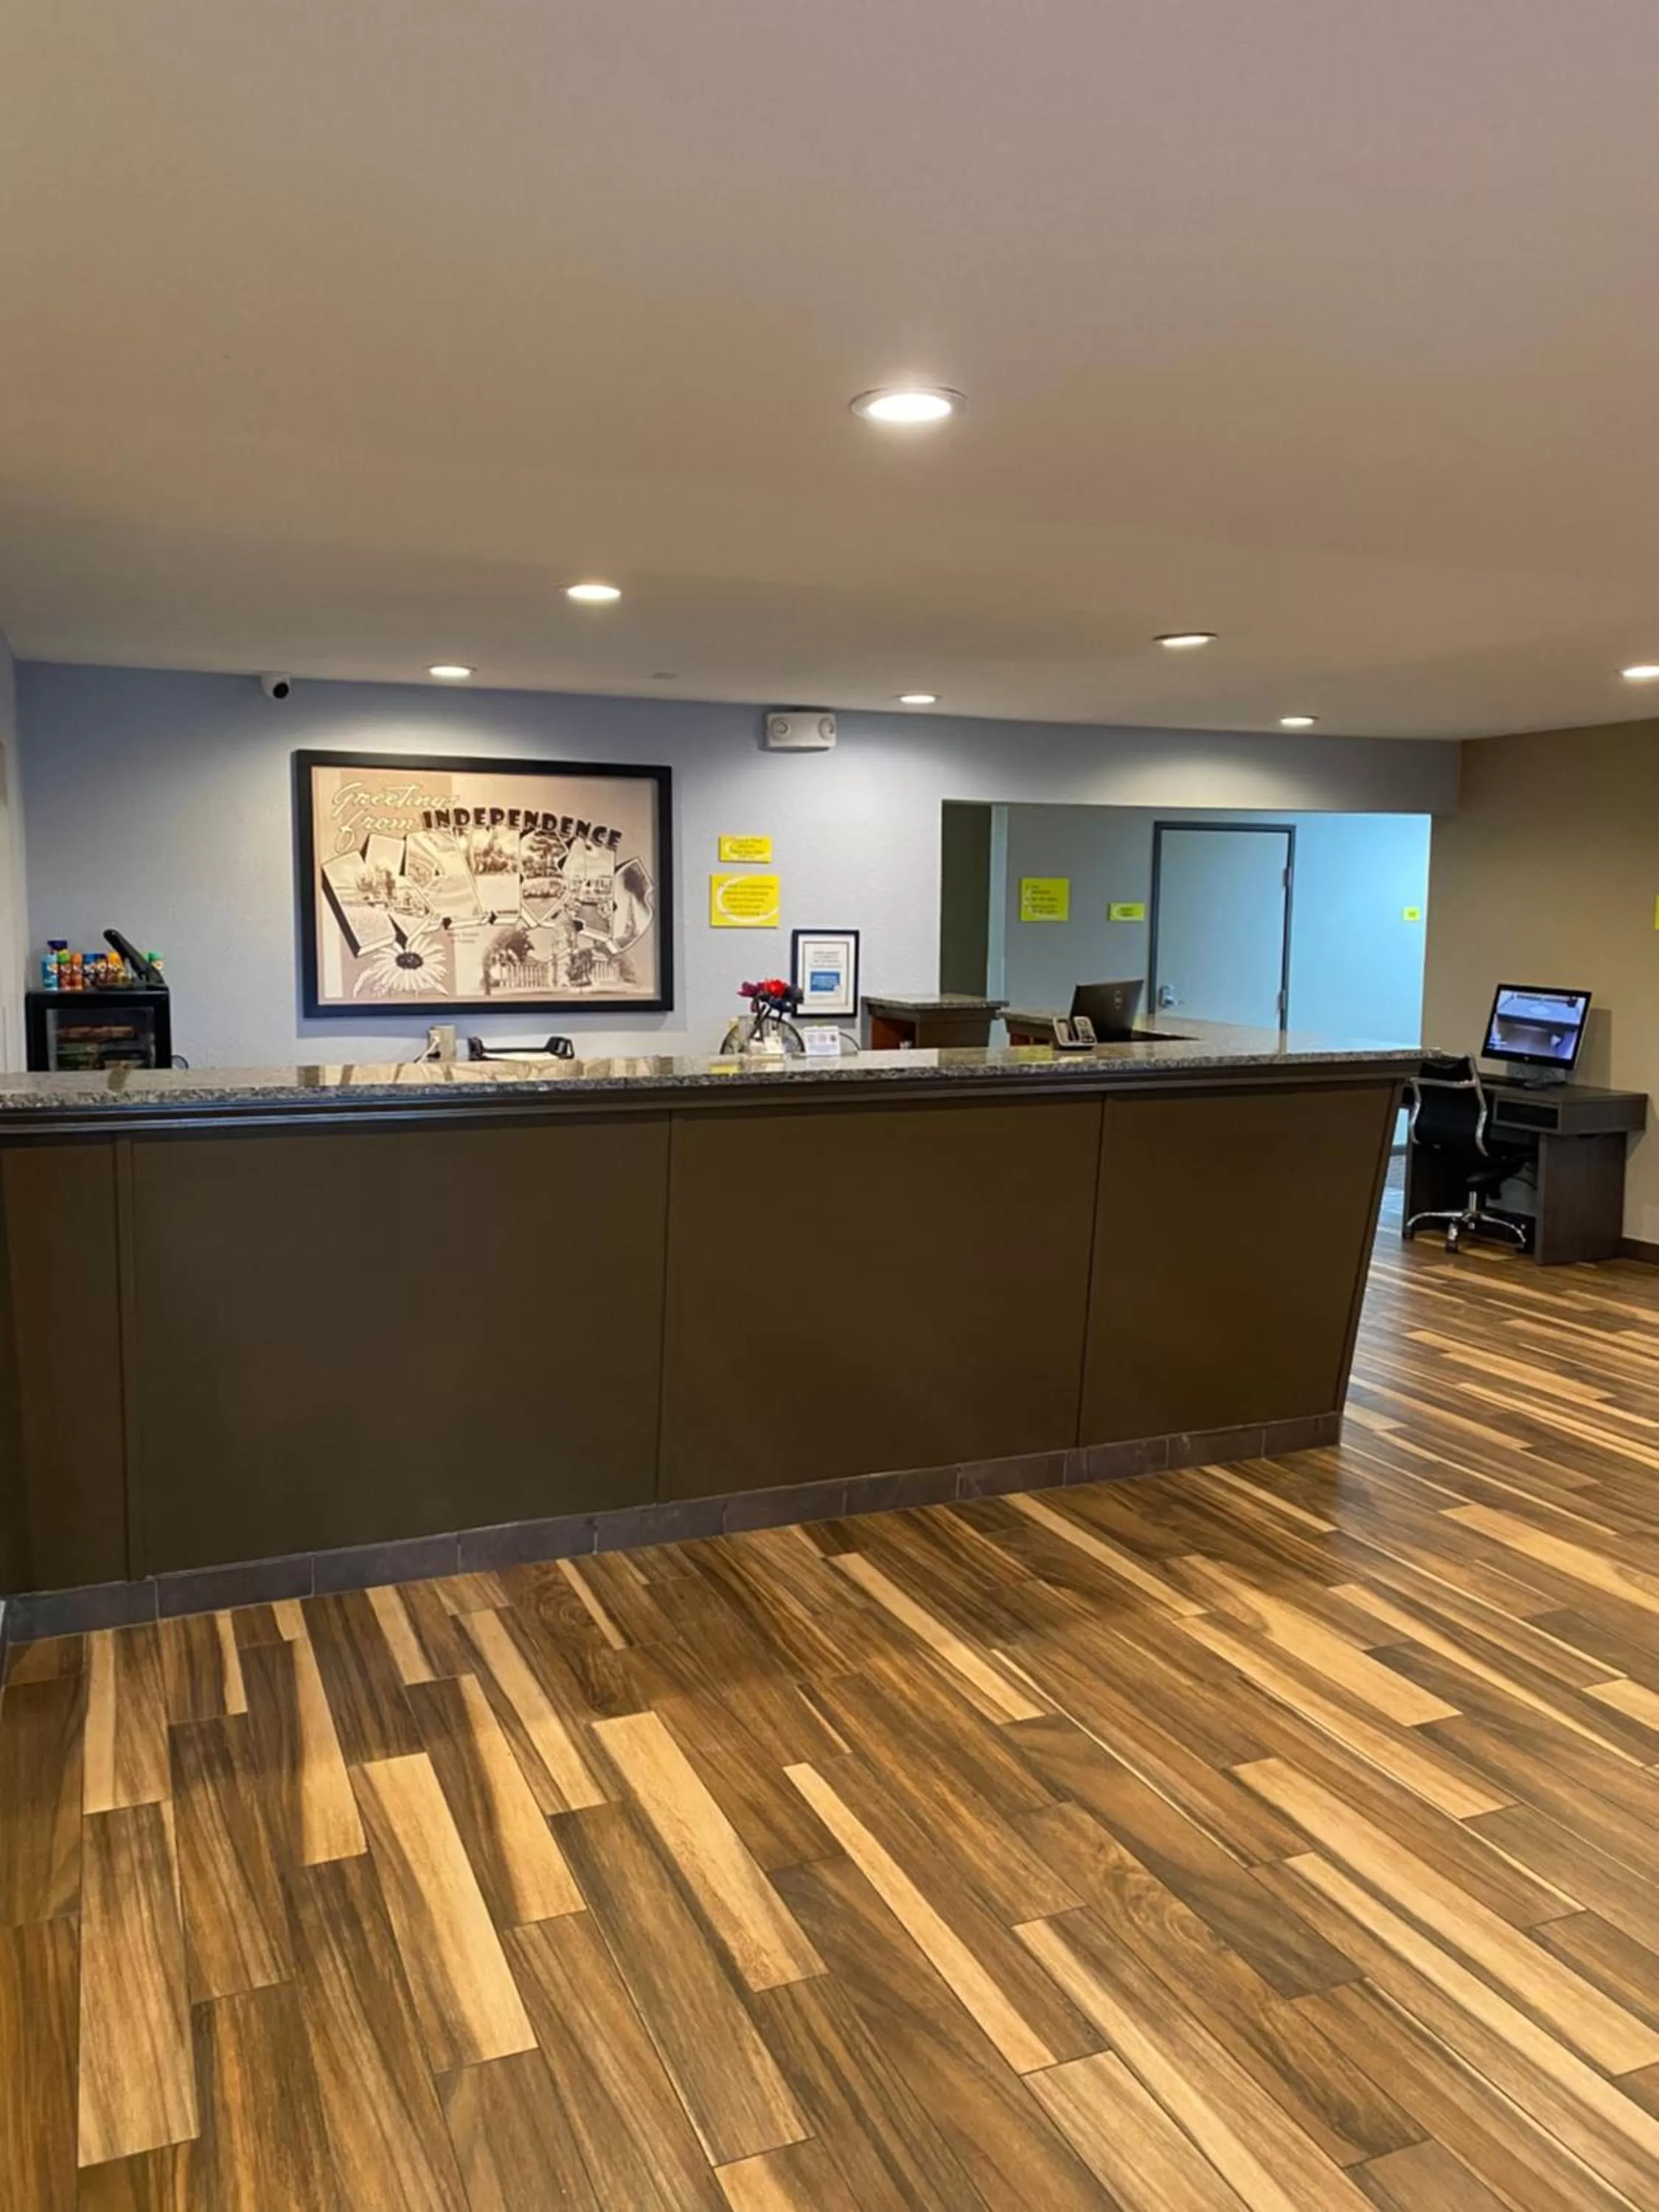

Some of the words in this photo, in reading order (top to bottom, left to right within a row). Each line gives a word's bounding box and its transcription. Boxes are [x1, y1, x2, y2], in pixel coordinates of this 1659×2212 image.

[332, 779, 460, 818] Greetings
[335, 809, 415, 854] from
[422, 807, 622, 848] INDEPENDENCE
